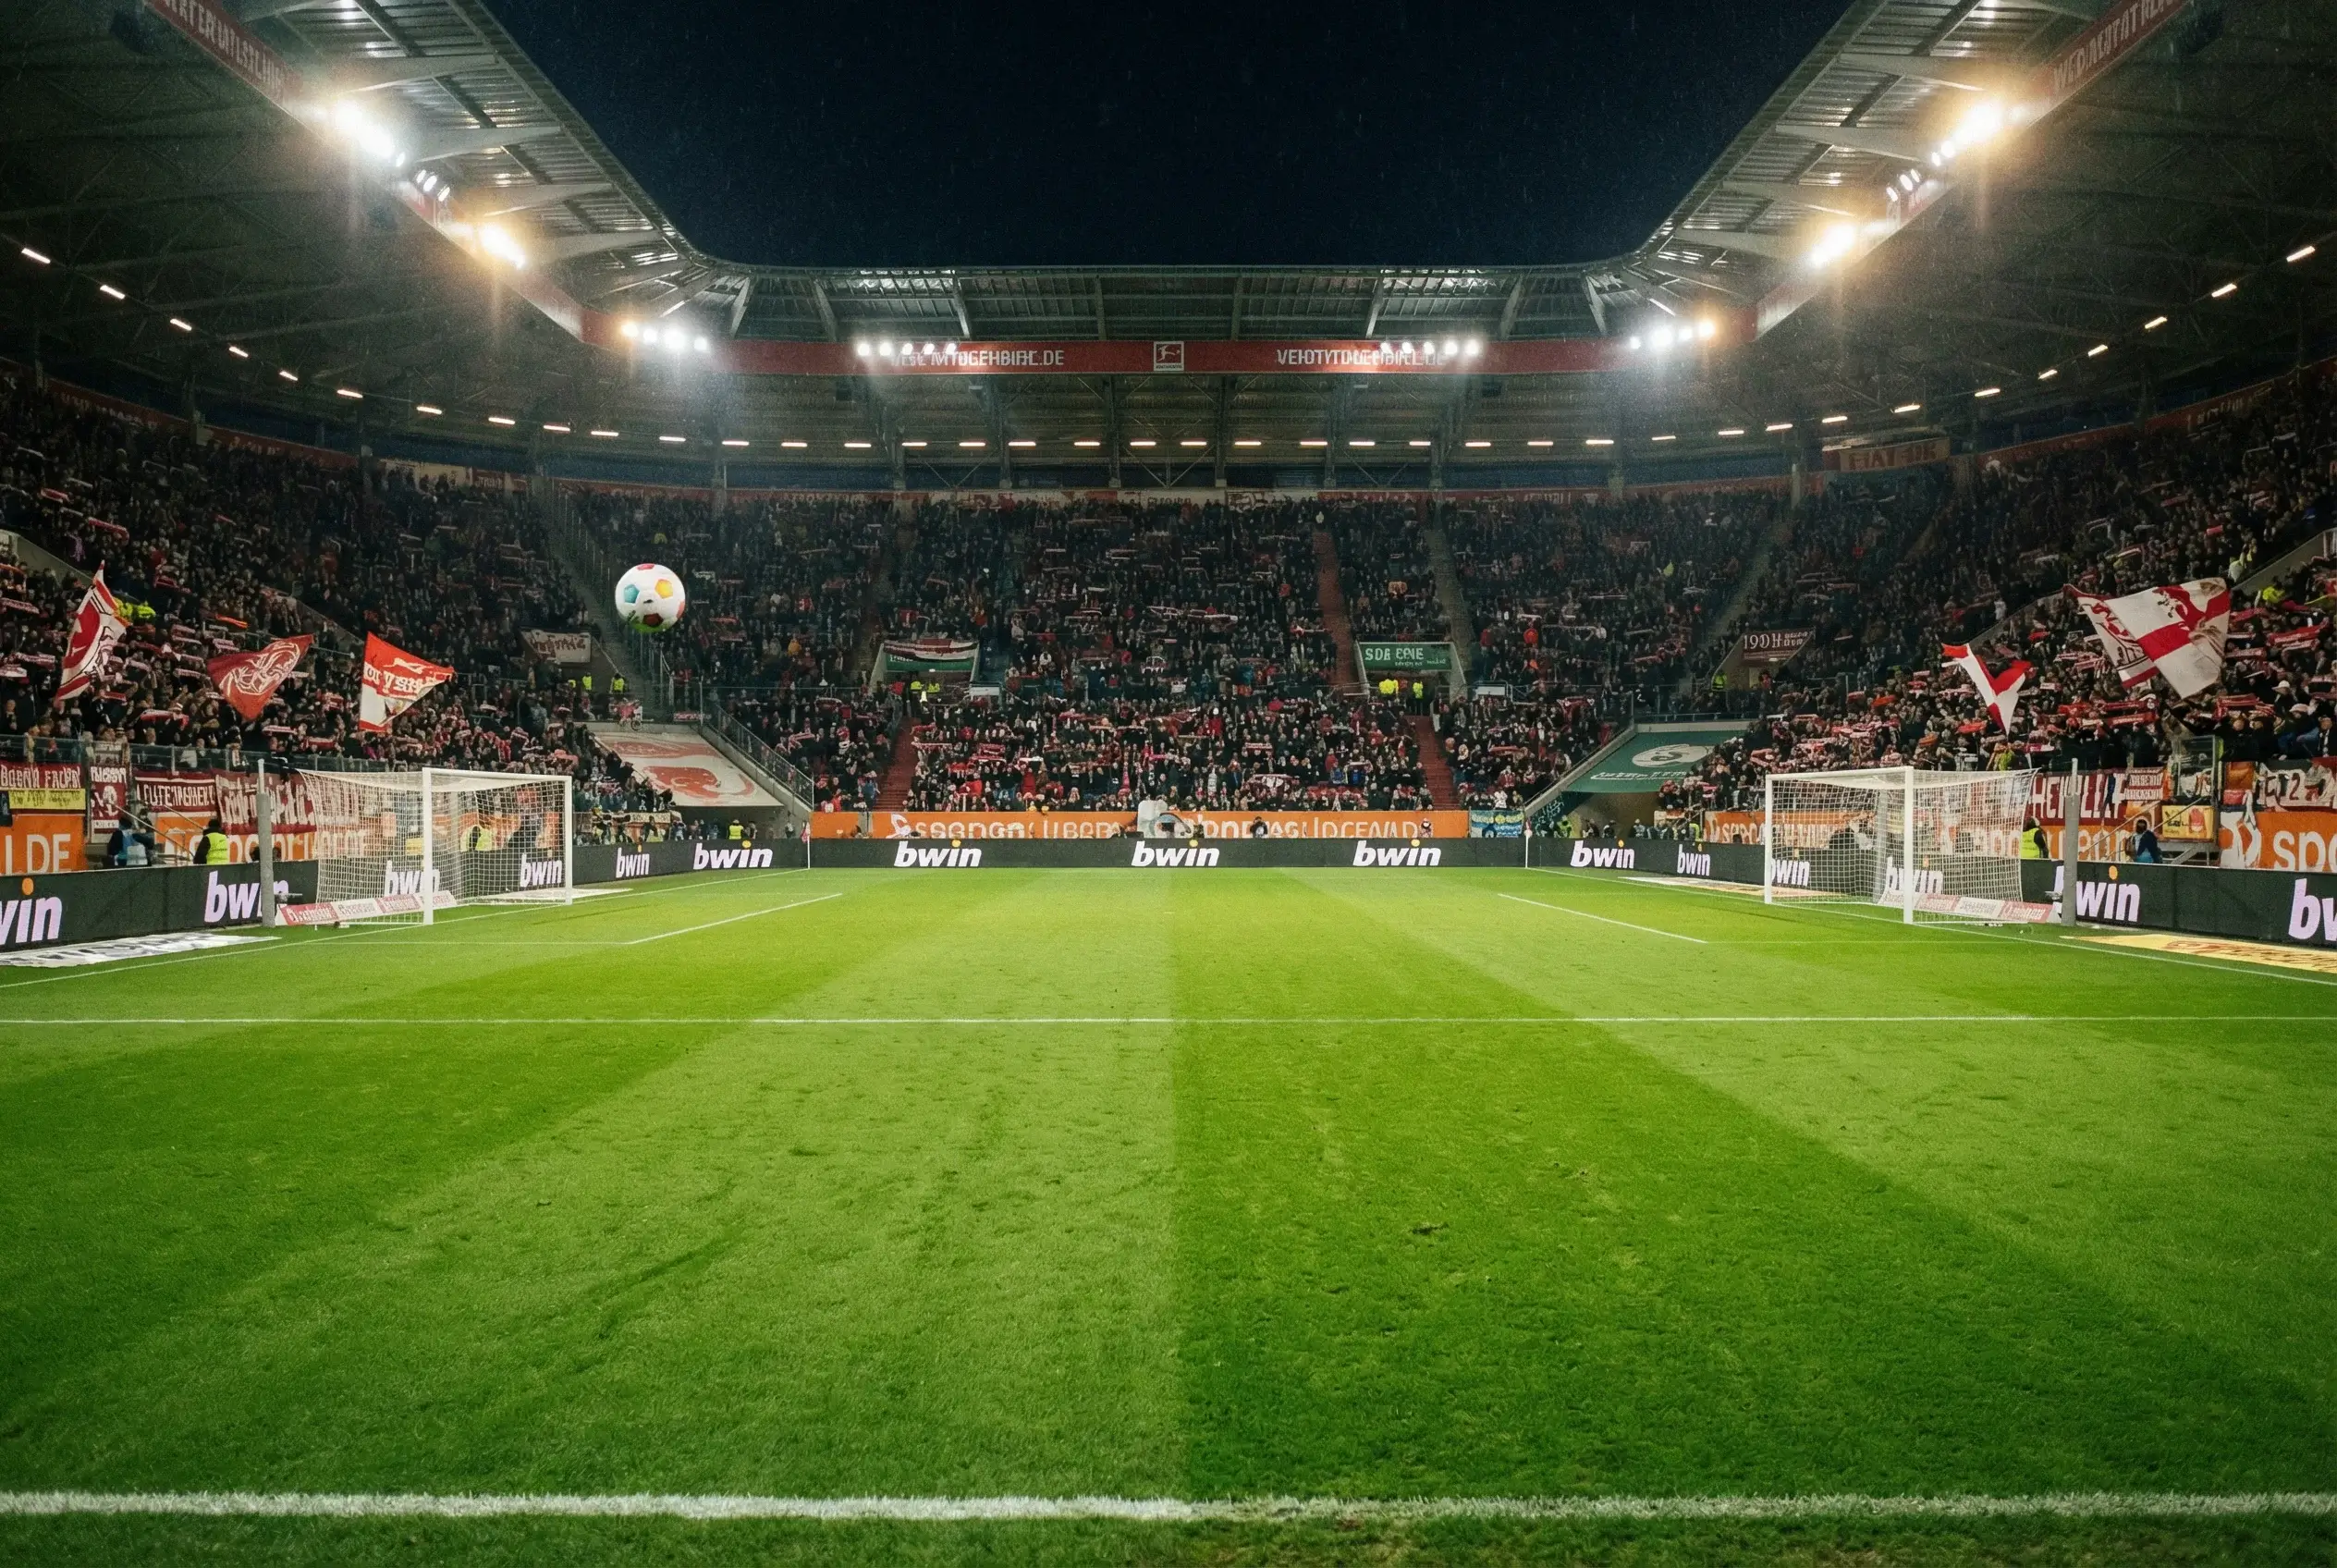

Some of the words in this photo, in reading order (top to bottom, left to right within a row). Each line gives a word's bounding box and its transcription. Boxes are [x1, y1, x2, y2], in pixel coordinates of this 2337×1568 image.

[616, 844, 650, 878] bwin
[693, 839, 774, 870] bwin
[893, 839, 983, 867] bwin
[1131, 839, 1220, 866] bwin
[1352, 838, 1442, 866] bwin
[1570, 839, 1635, 869] bwin
[1676, 843, 1711, 876] bwin
[520, 849, 563, 888] bwin
[203, 870, 289, 923] bwn
